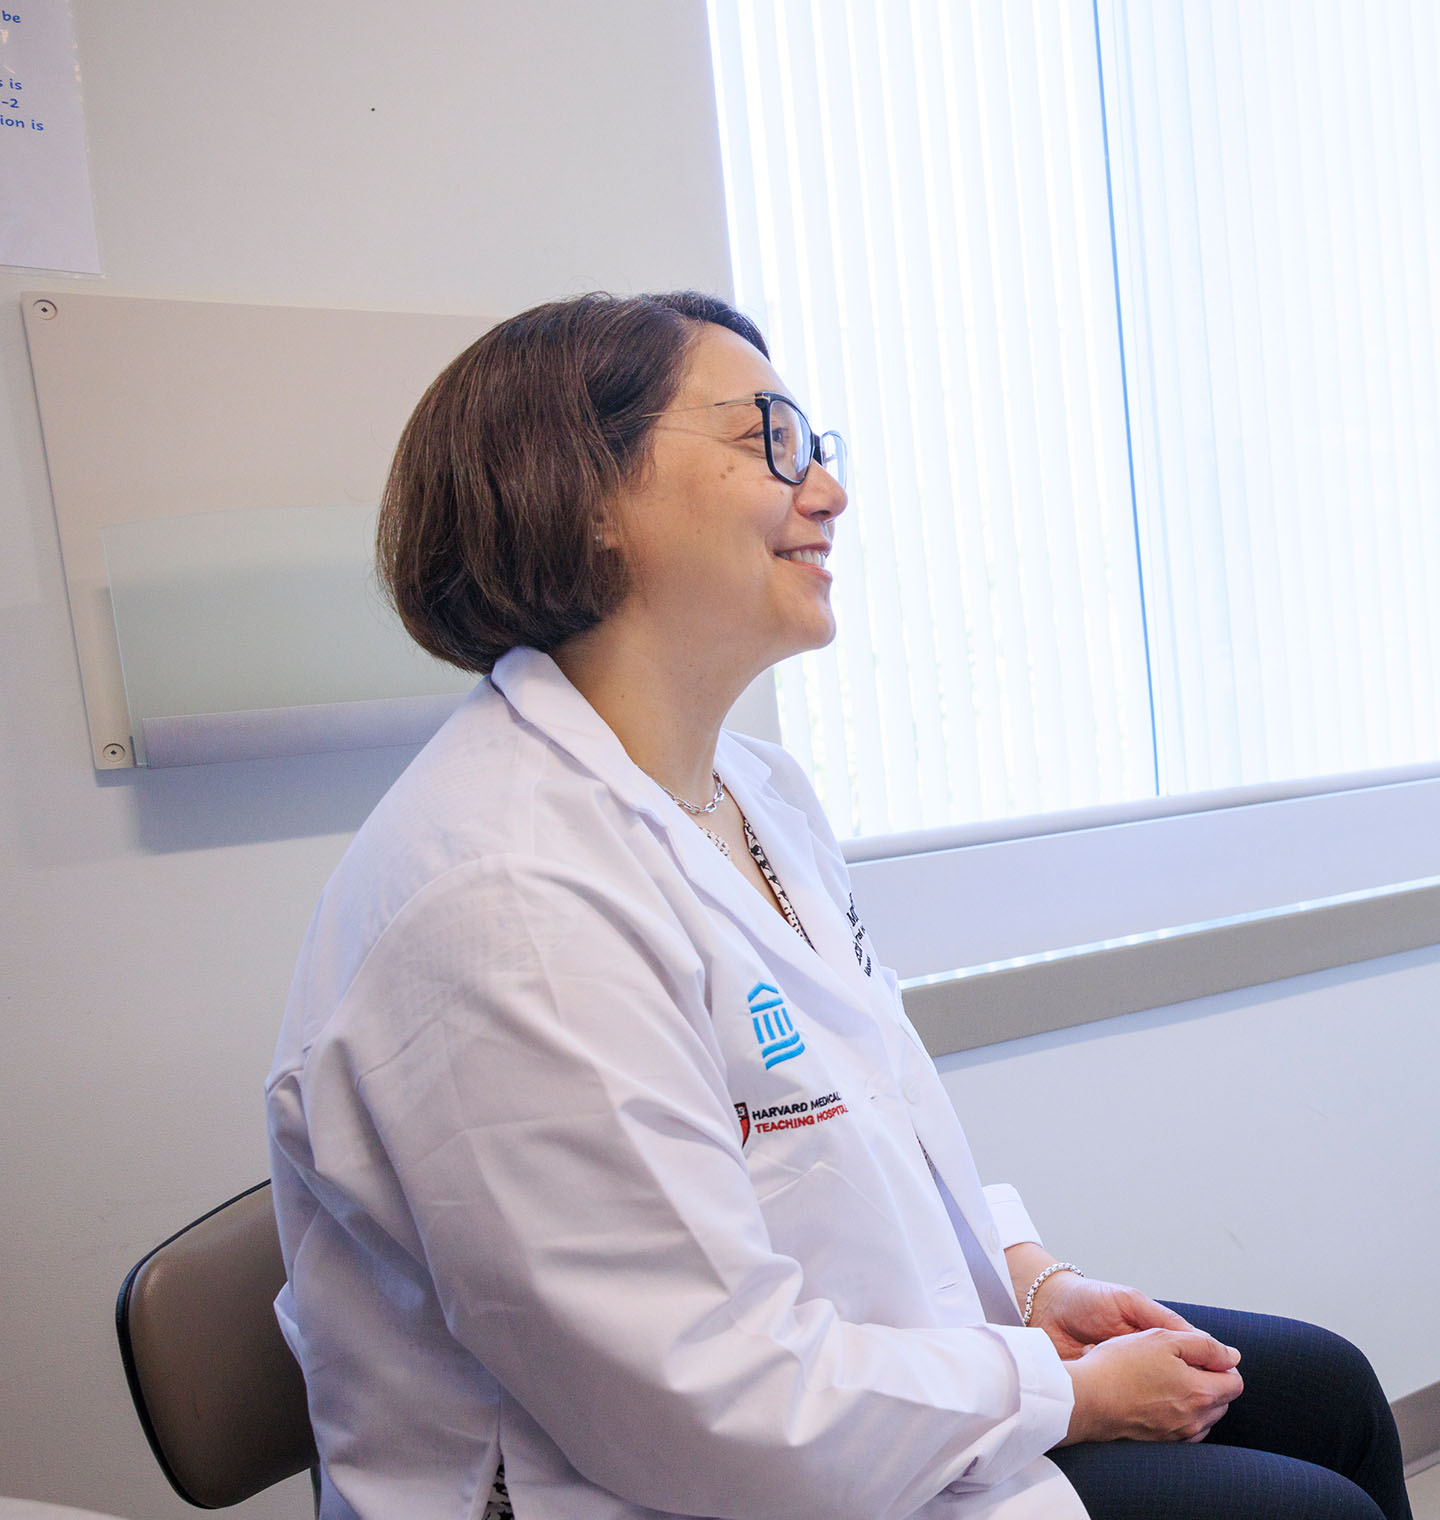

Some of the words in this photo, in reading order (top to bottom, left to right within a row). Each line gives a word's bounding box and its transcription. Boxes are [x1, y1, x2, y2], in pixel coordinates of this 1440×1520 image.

[2, 10, 21, 23] be
[9, 78, 23, 90] is
[31, 119, 44, 132] is
[752, 1102, 808, 1121] HARVARD
[810, 1091, 842, 1110] MEDICAL
[754, 1115, 815, 1134] TEACHING
